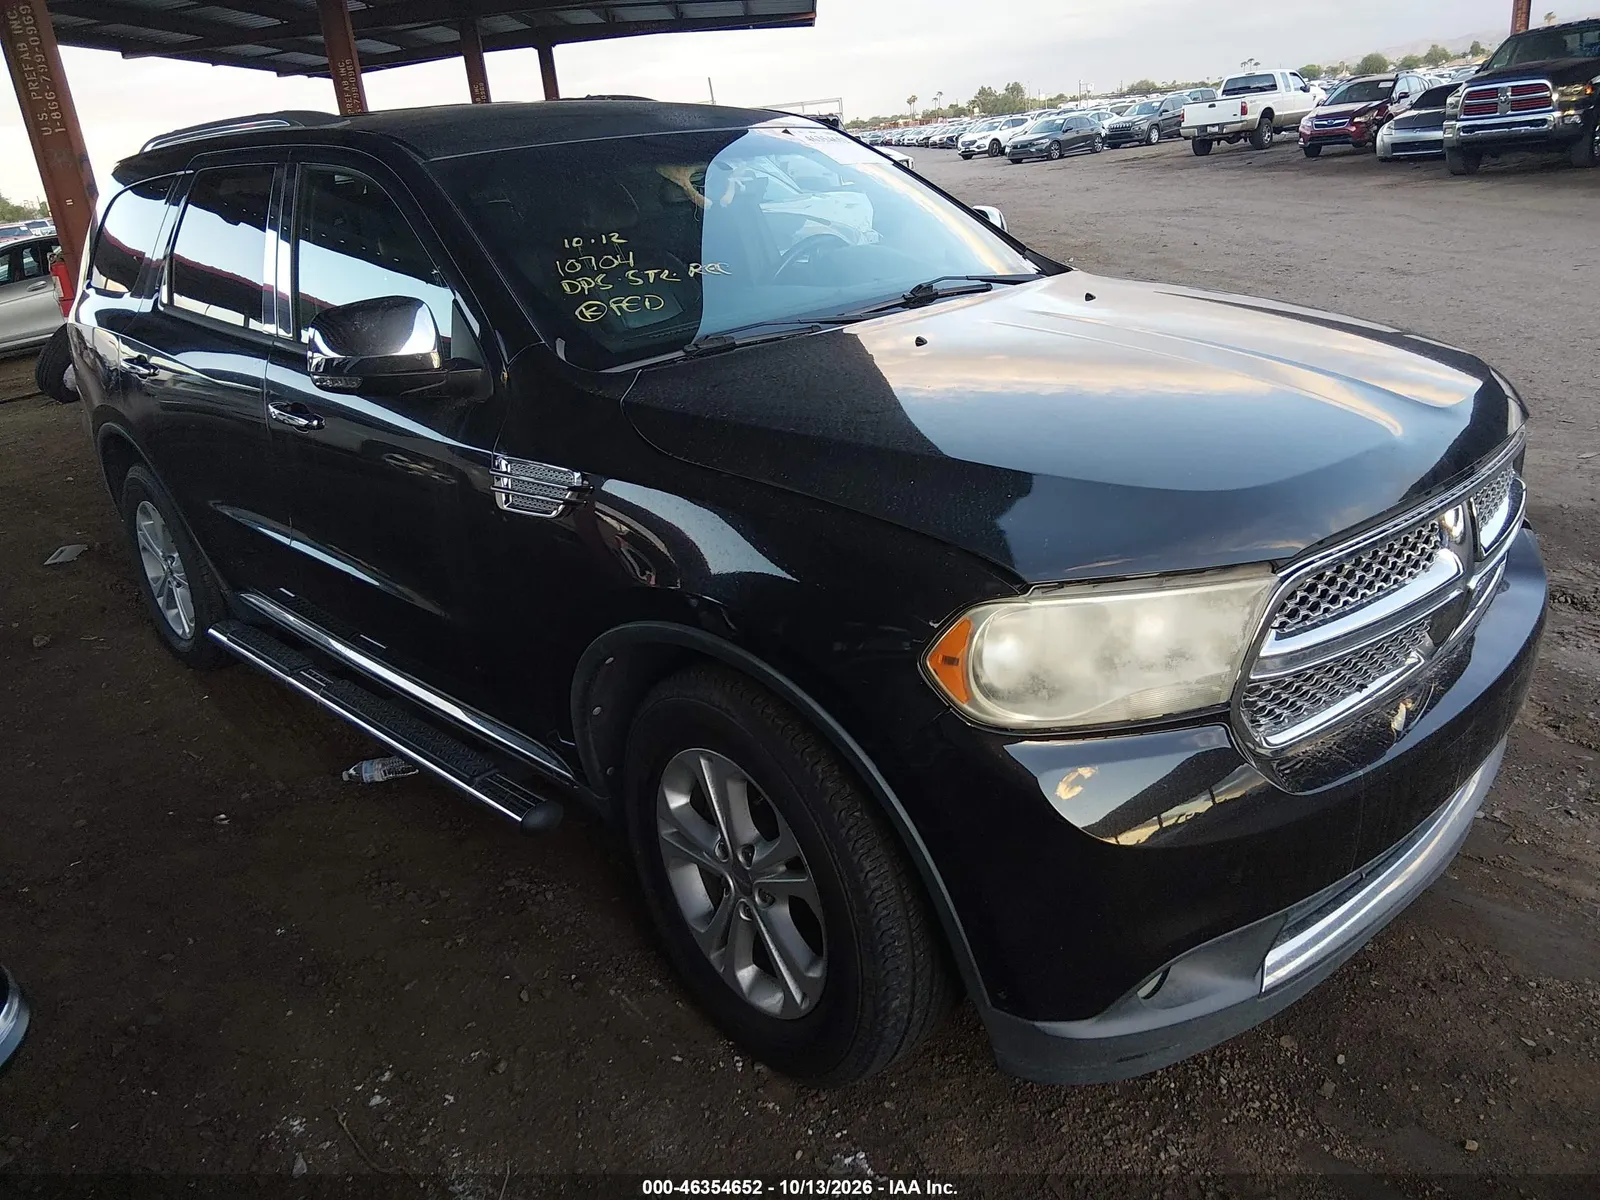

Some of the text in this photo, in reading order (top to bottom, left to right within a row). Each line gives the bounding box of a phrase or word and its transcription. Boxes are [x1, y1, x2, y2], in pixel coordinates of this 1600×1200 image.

[7, 4, 24, 35] INC.
[16, 42, 43, 101] PREFAB
[341, 80, 355, 115] PREFAB
